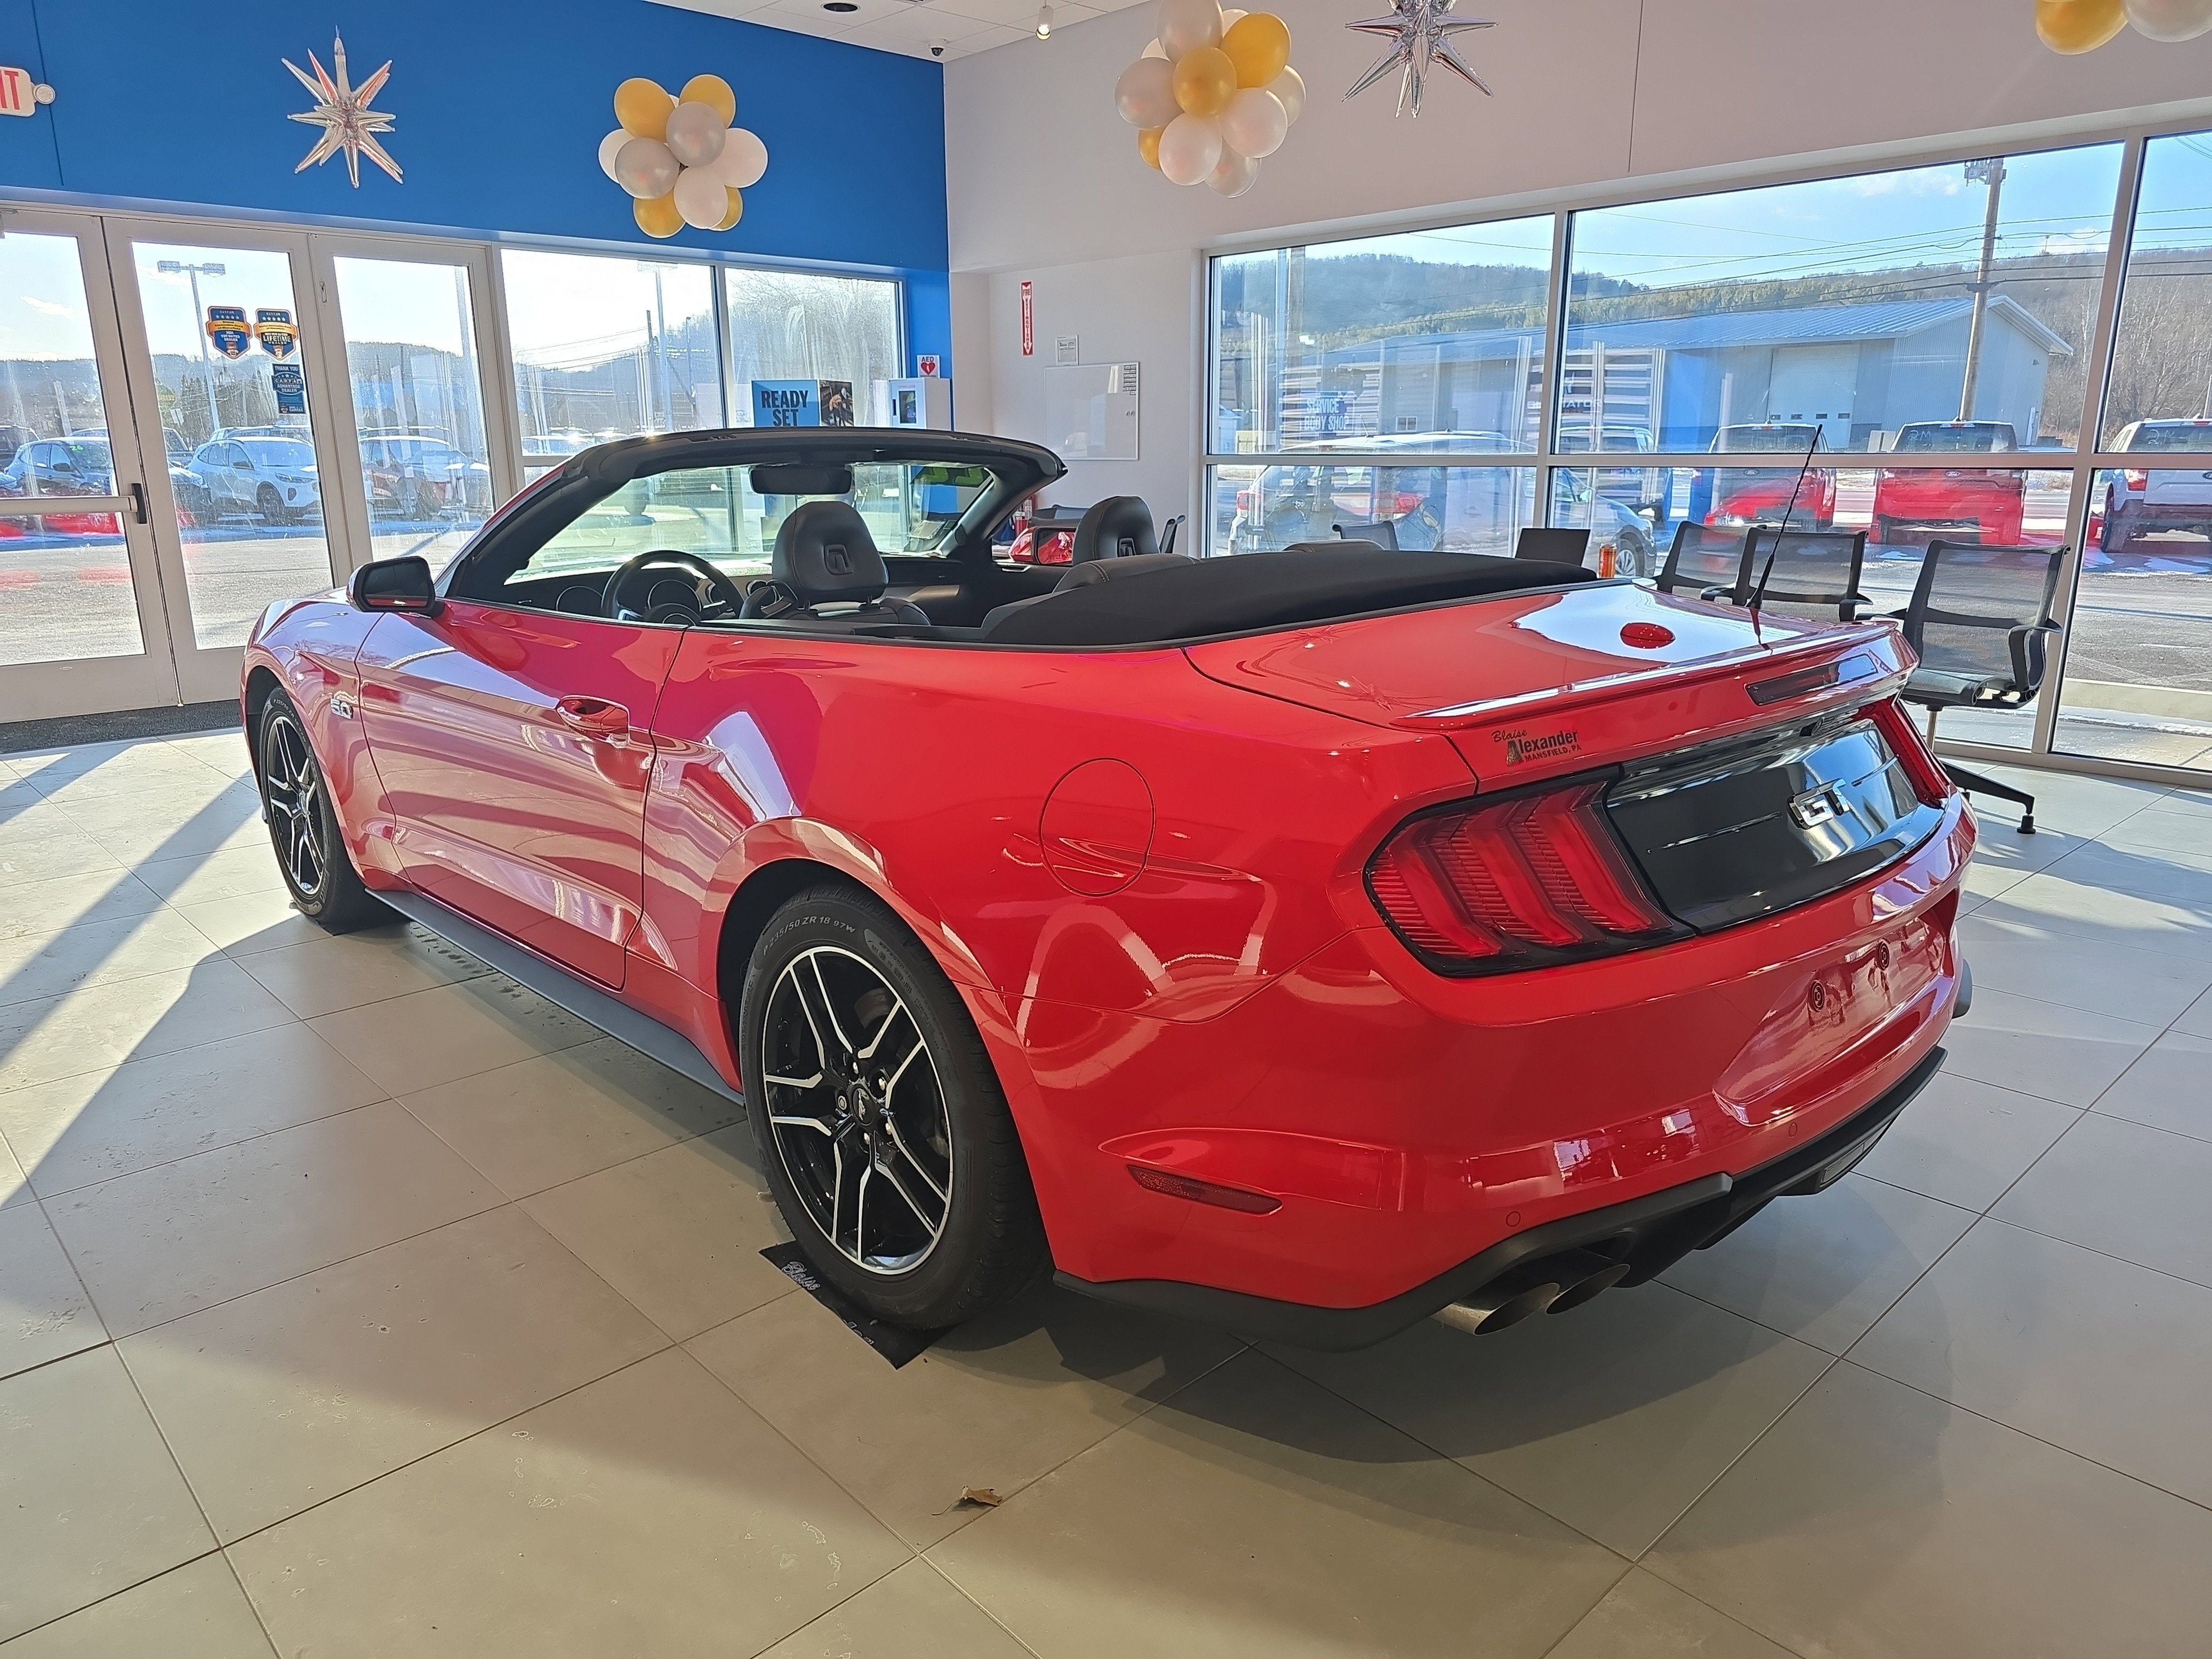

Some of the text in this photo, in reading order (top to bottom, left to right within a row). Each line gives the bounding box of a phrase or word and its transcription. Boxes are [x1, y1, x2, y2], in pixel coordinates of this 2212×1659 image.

[761, 390, 808, 409] READY
[1307, 398, 1339, 414] SERVICE
[773, 409, 799, 427] SET
[1304, 415, 1349, 430] BODY SHOP
[1491, 729, 1527, 742] Blaise
[1506, 730, 1578, 766] Alexander
[1525, 744, 1582, 761] MANSFIELD, PA
[1787, 777, 1850, 830] GT
[763, 916, 856, 956] P 235/50 ZR 18 97W
